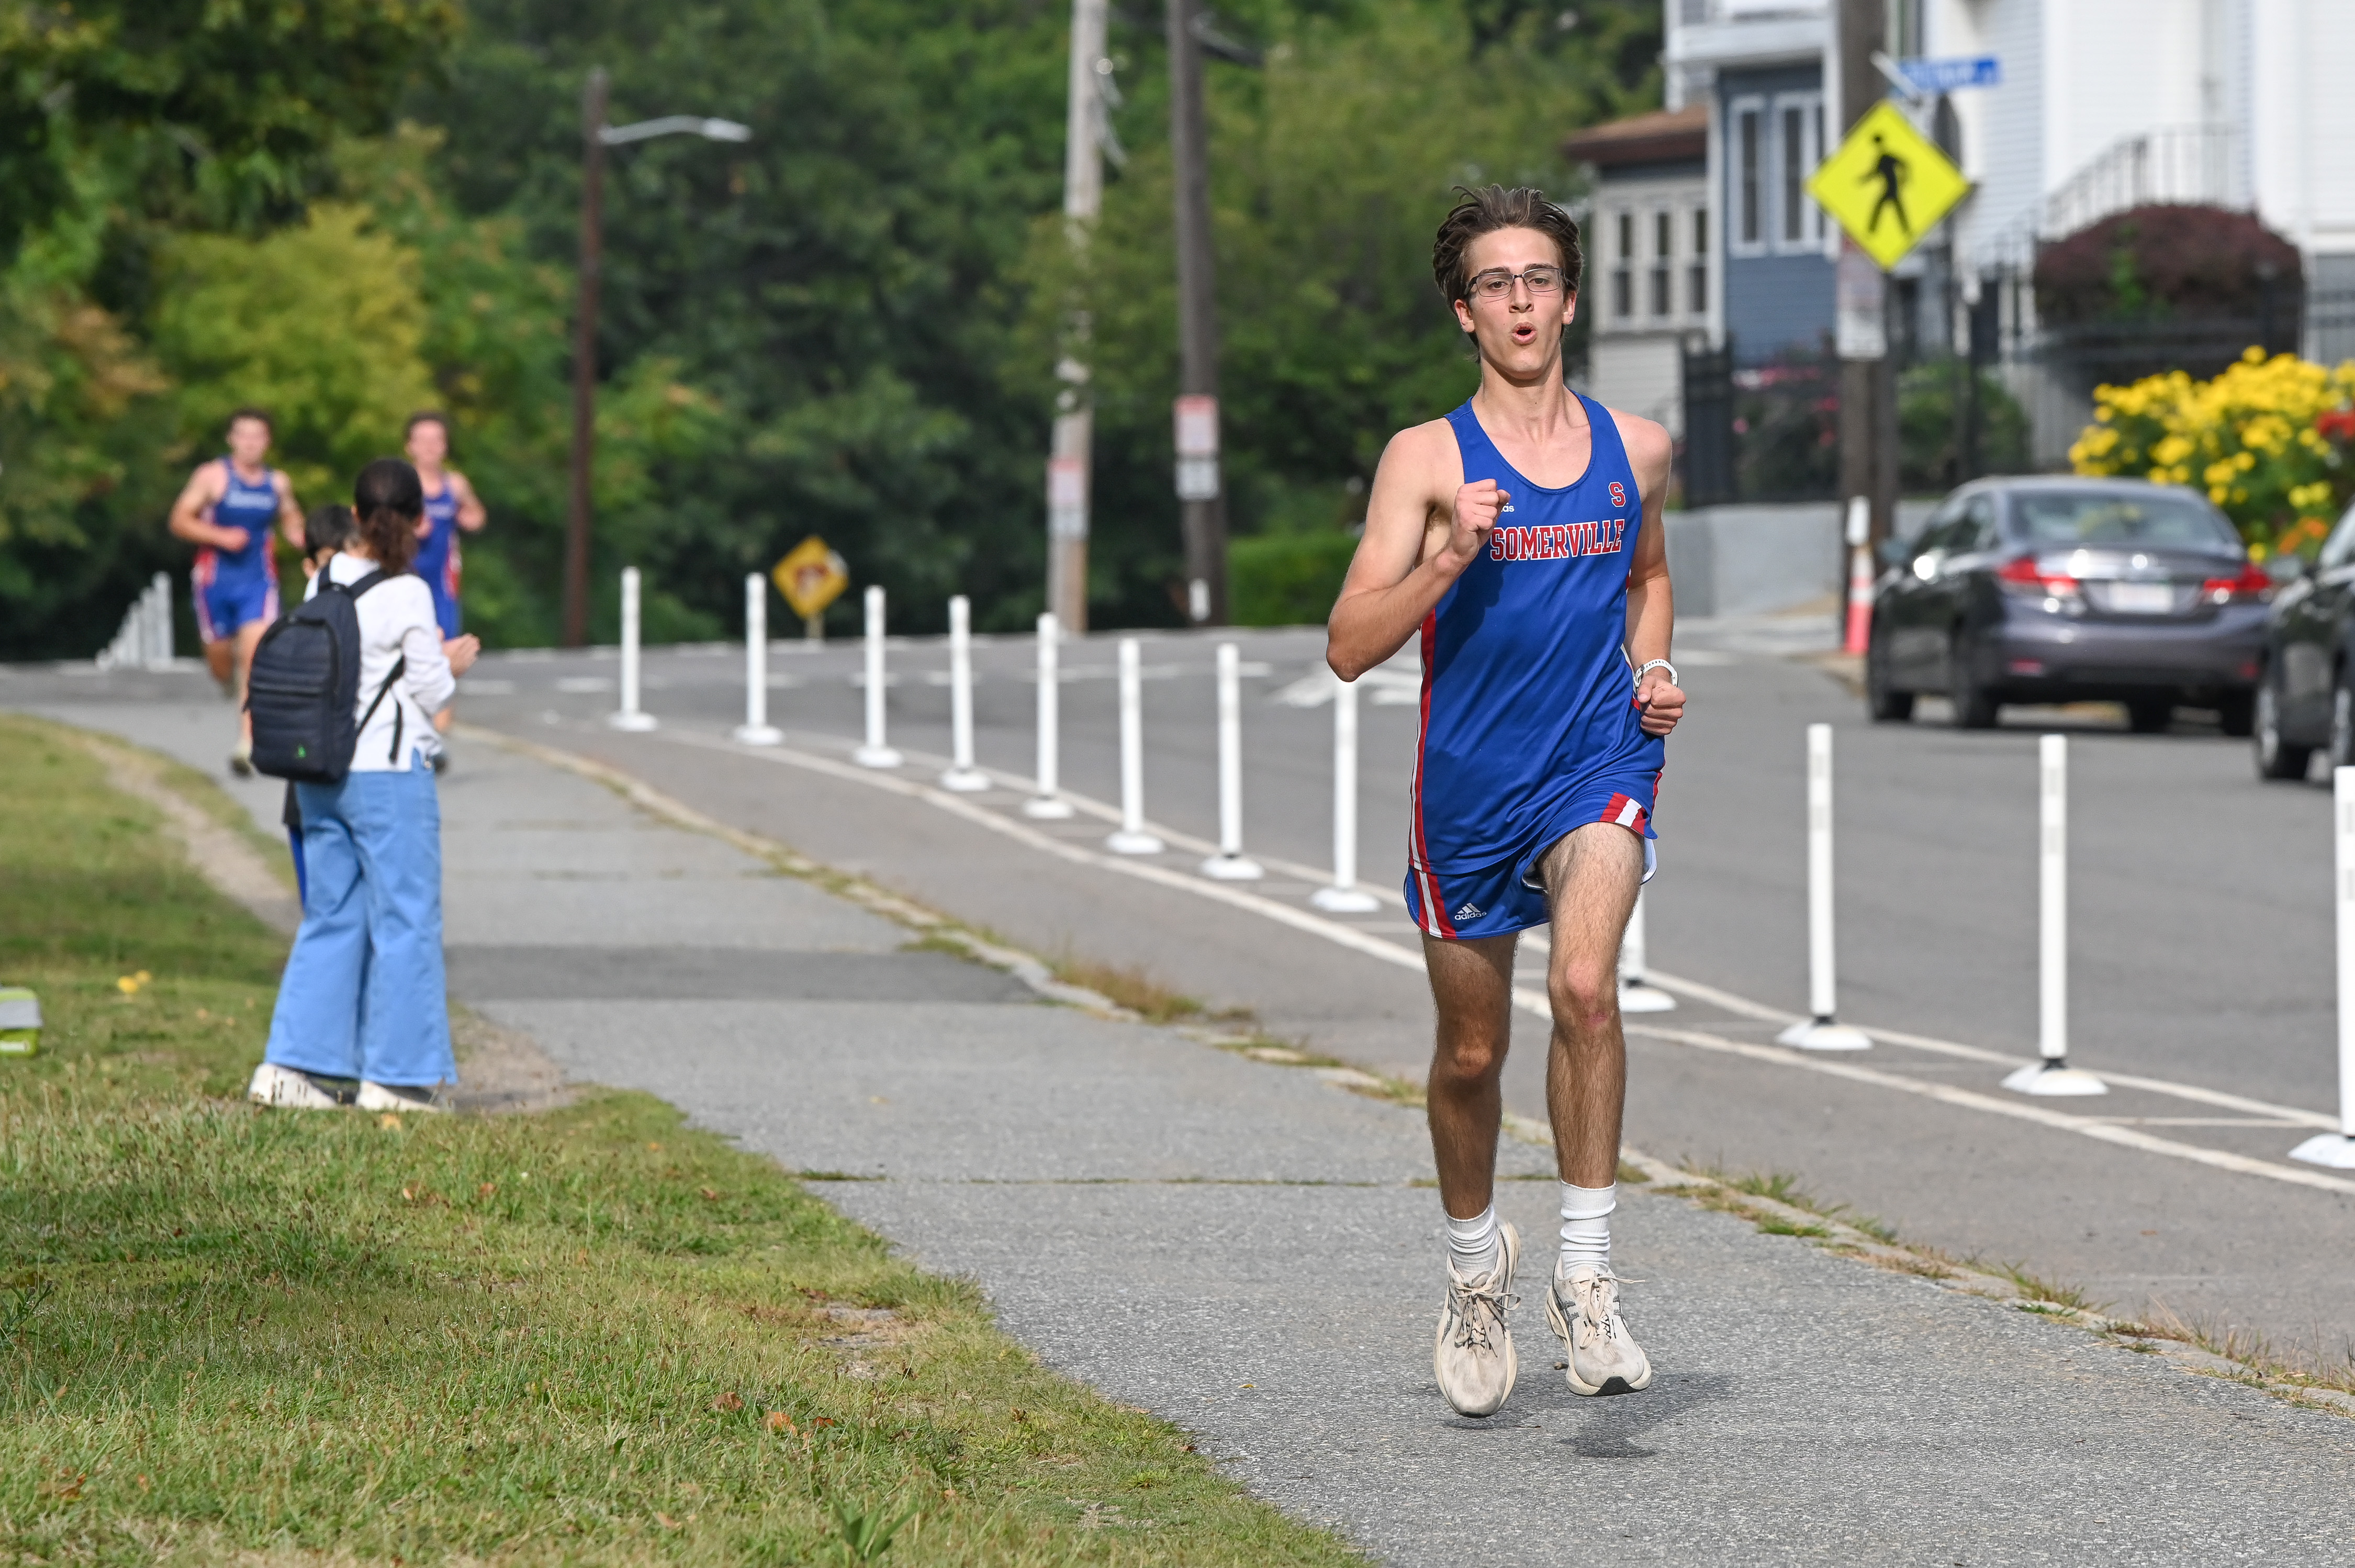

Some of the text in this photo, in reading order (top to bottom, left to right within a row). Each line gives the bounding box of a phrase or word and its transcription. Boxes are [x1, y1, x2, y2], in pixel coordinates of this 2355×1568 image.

[1608, 481, 1626, 507] S
[1490, 519, 1625, 561] SOMERVILLE
[1454, 911, 1487, 920] adidas
